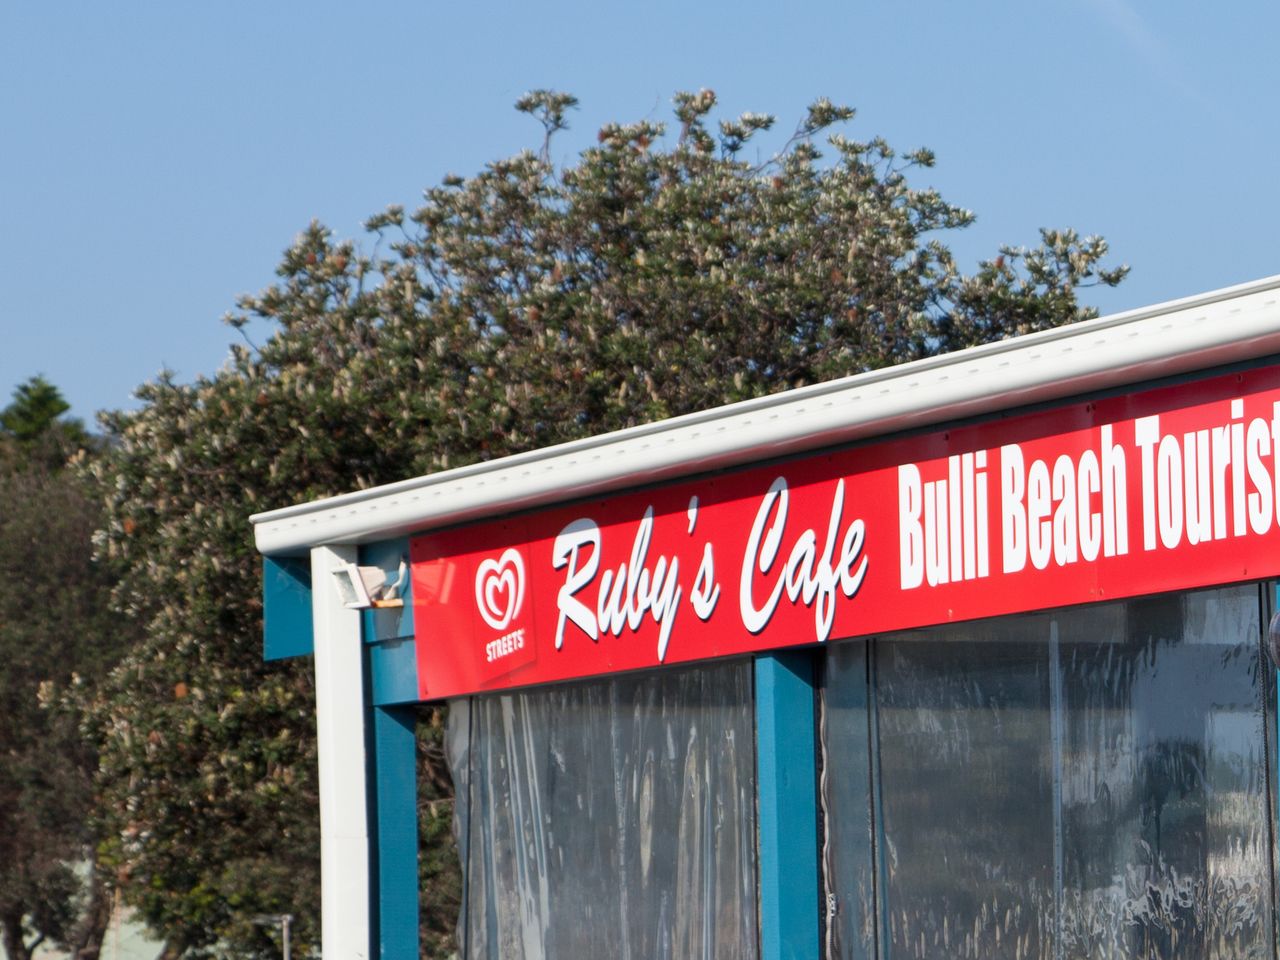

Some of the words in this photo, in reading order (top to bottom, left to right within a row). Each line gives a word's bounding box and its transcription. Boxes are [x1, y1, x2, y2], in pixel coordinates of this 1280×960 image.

[553, 496, 720, 662] Ruby's
[740, 476, 868, 642] Cafe
[899, 450, 989, 590] Bulli
[1001, 423, 1129, 574] Beach
[486, 629, 524, 662] STREETS
